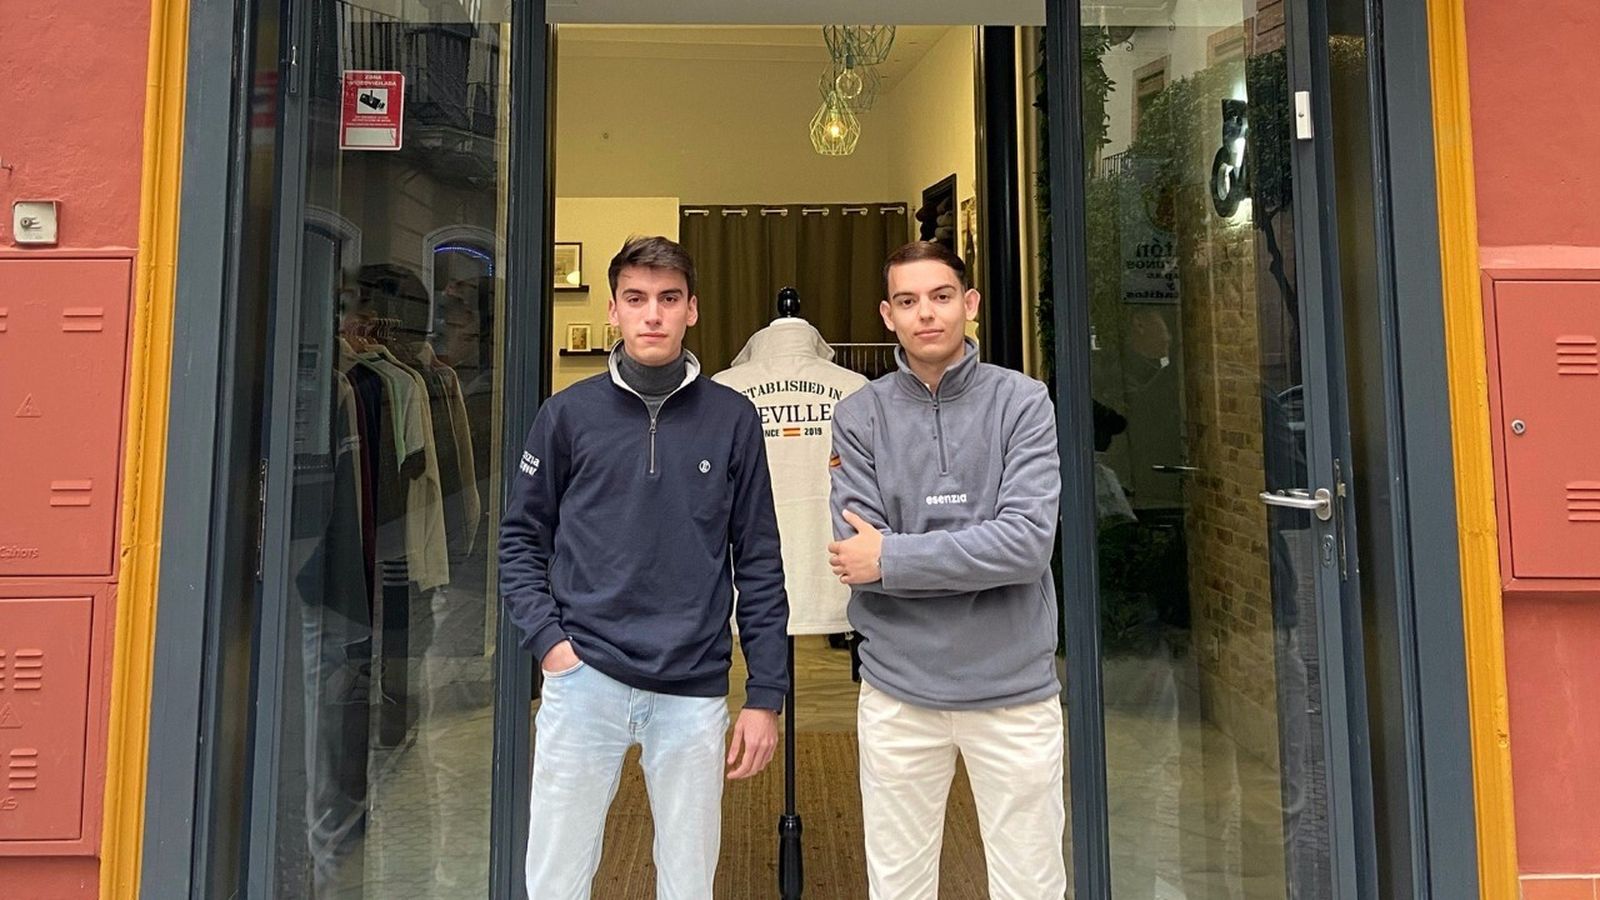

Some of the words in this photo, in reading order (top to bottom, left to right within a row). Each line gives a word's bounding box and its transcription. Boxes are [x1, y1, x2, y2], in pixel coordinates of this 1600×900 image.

[742, 380, 825, 398] TABLISHED
[828, 387, 842, 400] IN
[757, 403, 832, 424] EVILLE
[765, 429, 780, 437] NCE
[804, 427, 822, 436] 2019
[925, 493, 967, 505] esenzia
